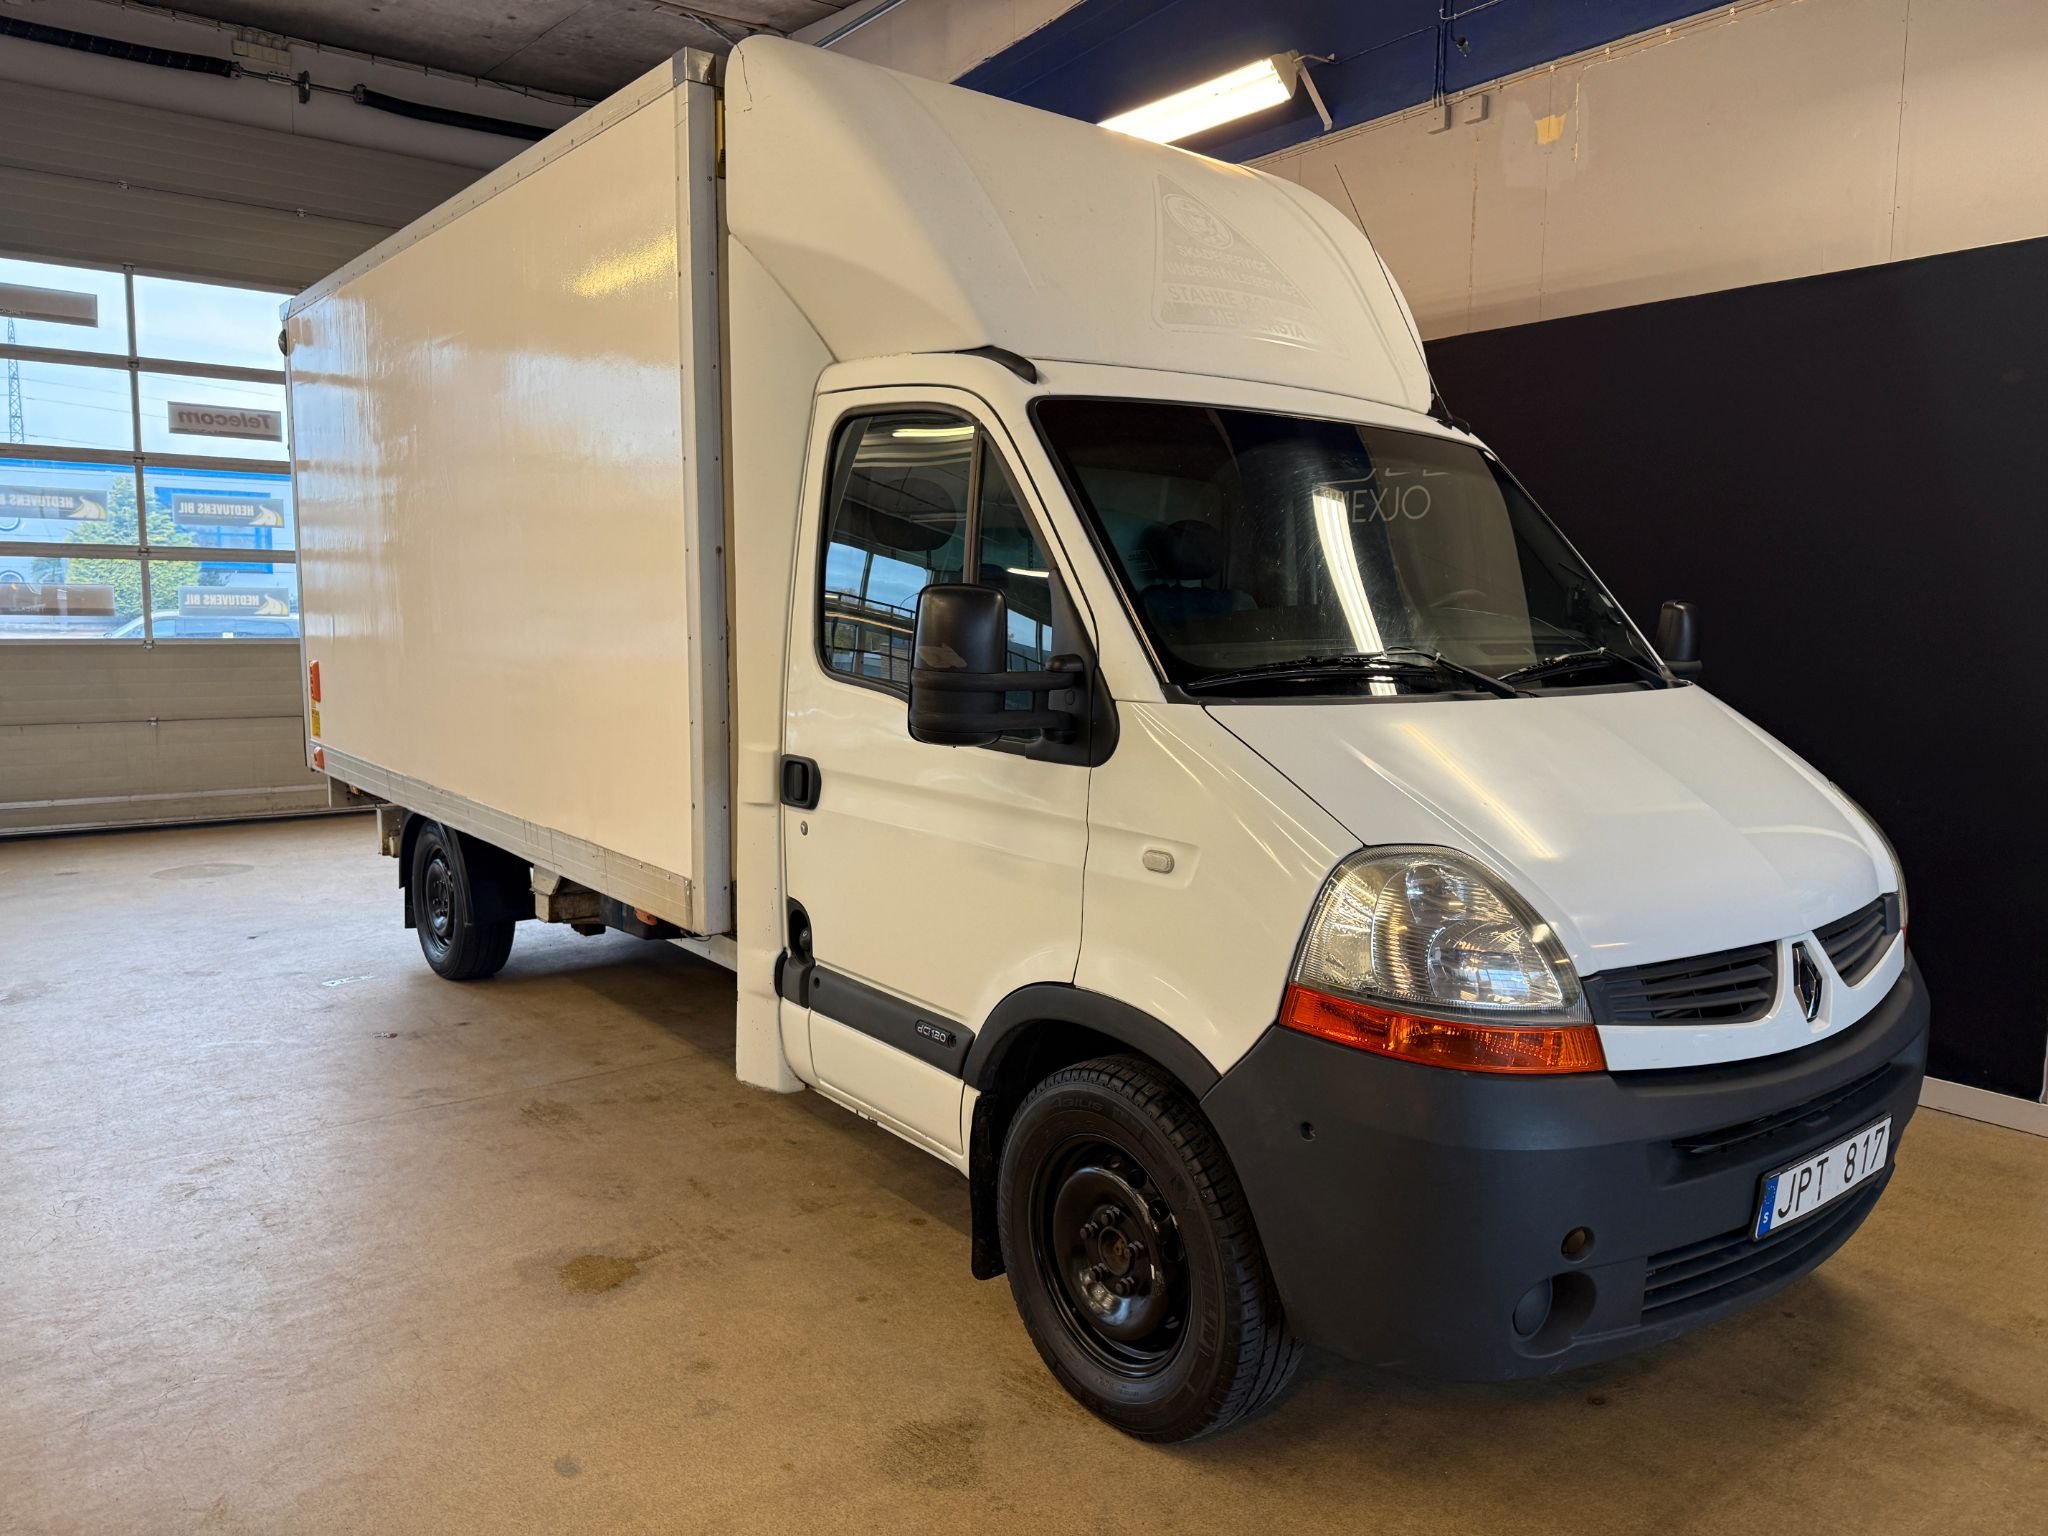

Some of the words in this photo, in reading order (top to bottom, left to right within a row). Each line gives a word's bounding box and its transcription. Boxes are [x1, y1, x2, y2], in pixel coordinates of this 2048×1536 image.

[1762, 1212, 1769, 1224] S
[1777, 1156, 1829, 1218] JPT
[1844, 1126, 1886, 1183] 817
